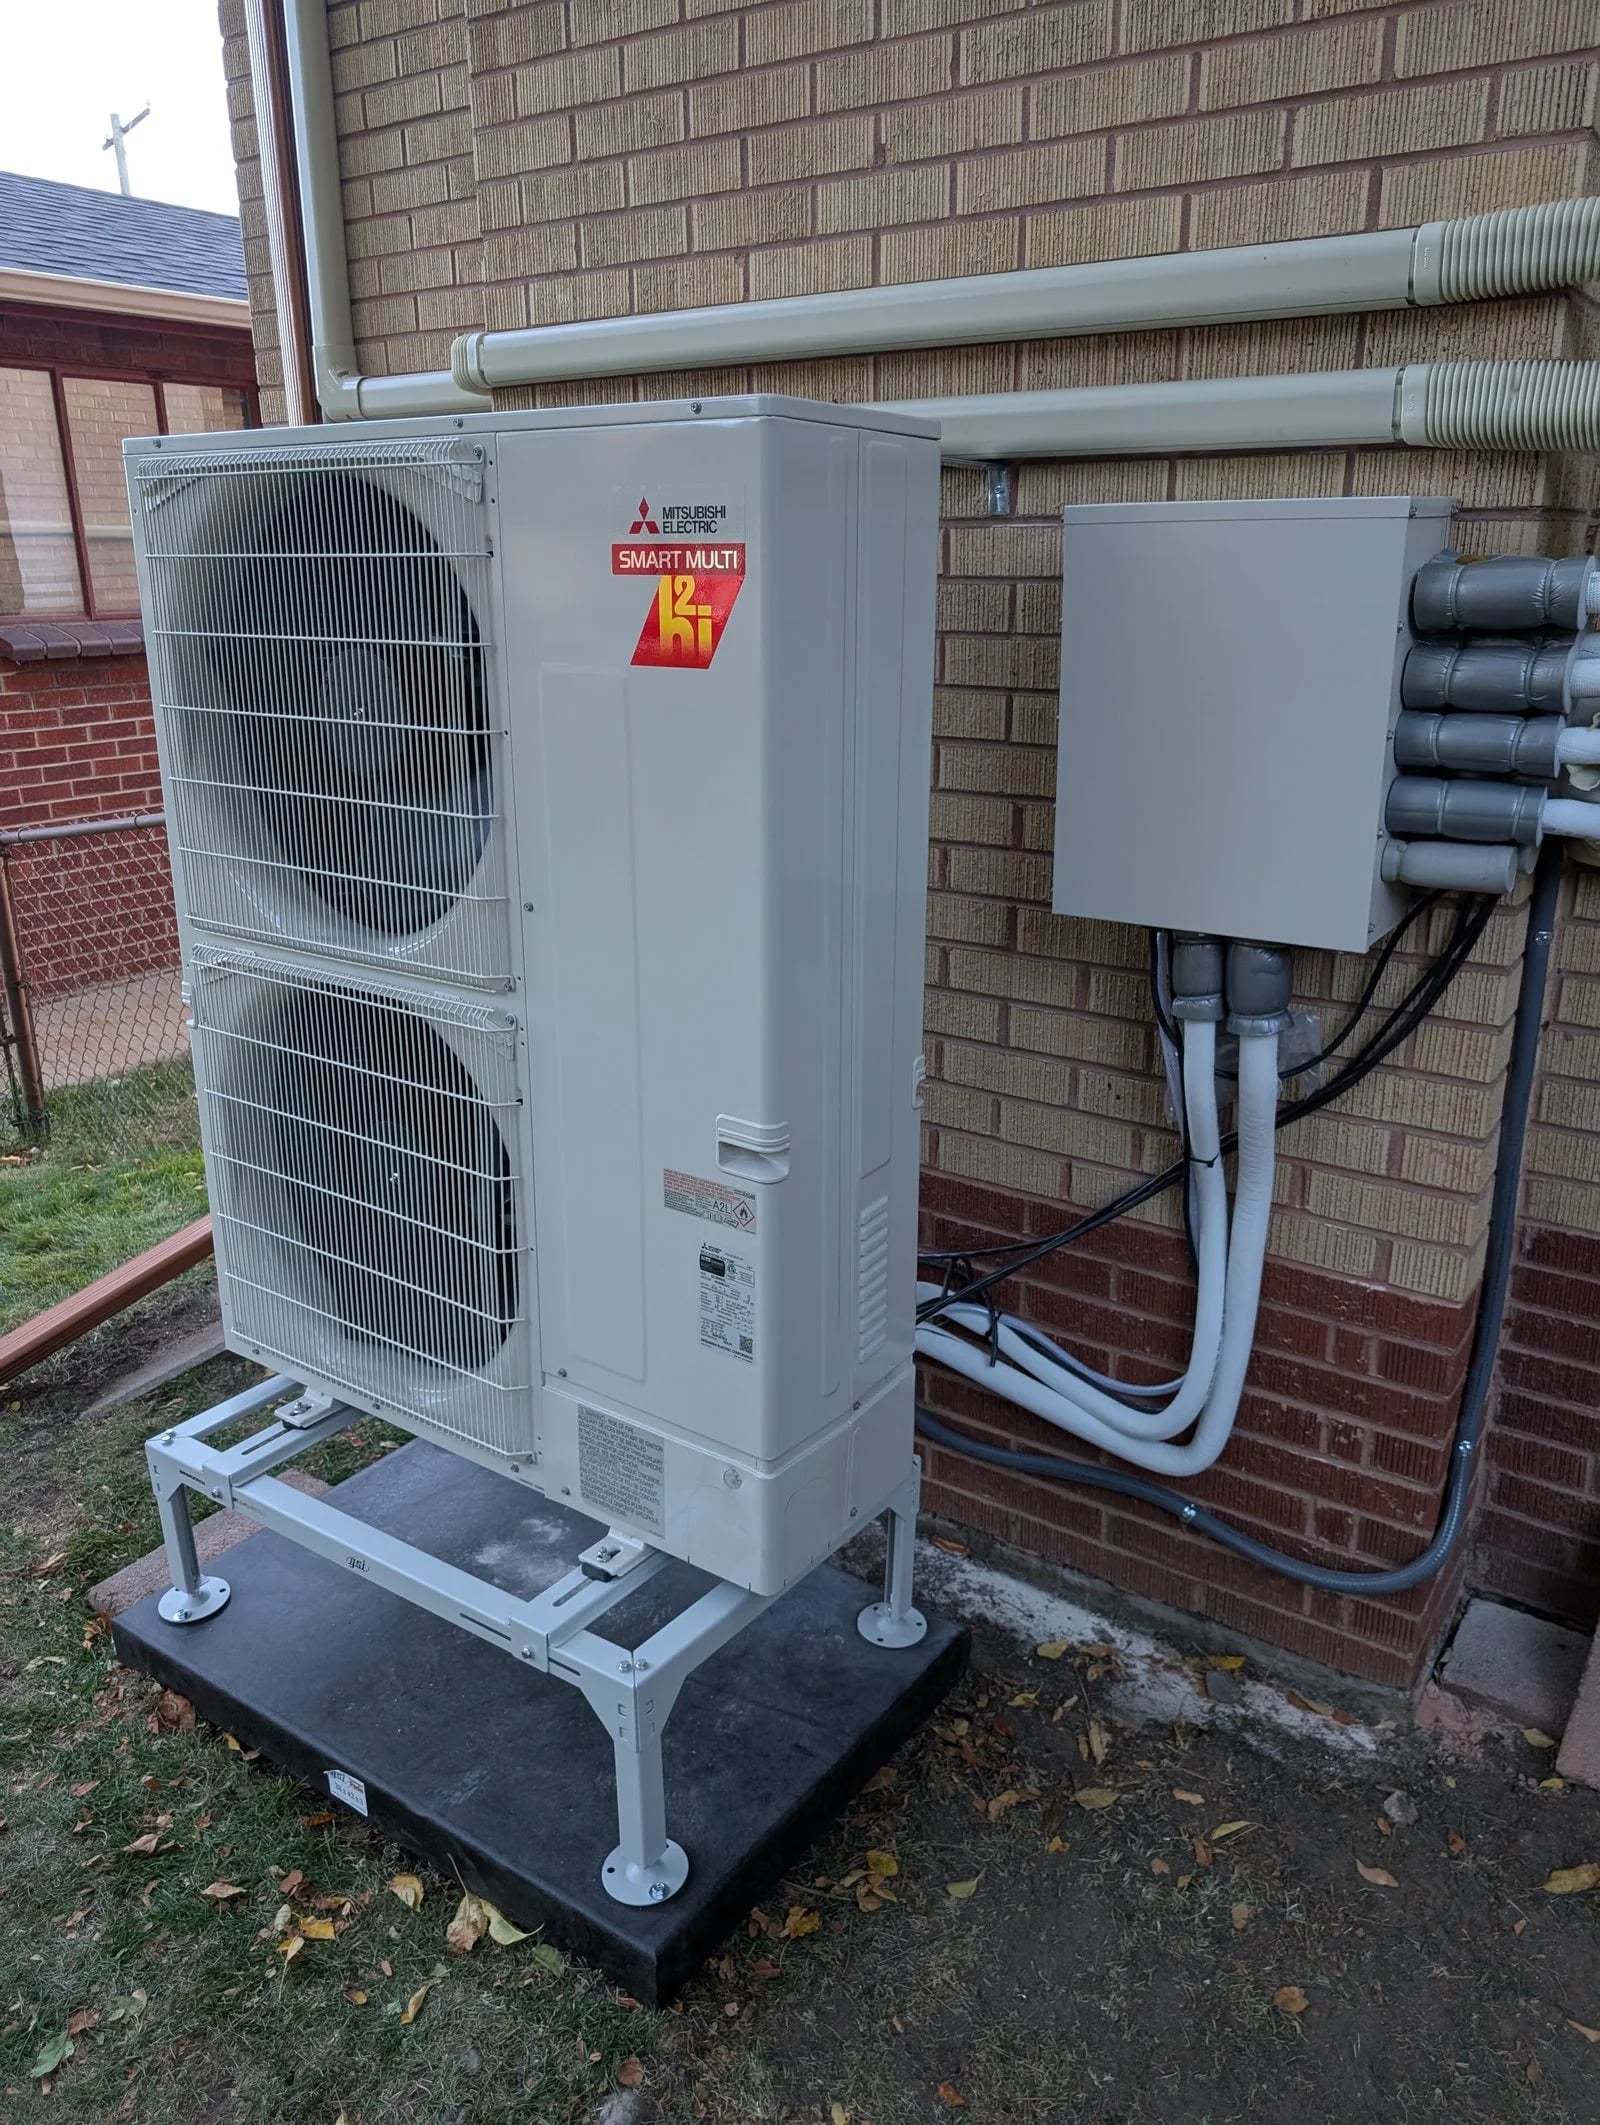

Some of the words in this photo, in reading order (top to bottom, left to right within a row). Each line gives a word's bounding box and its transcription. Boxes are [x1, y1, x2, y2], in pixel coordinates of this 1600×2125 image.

[663, 505, 726, 519] MITSUBISHI
[663, 520, 718, 534] ELECTRIC
[619, 550, 682, 569] SMART
[685, 550, 738, 569] MULTI
[712, 1200, 731, 1214] A2L
